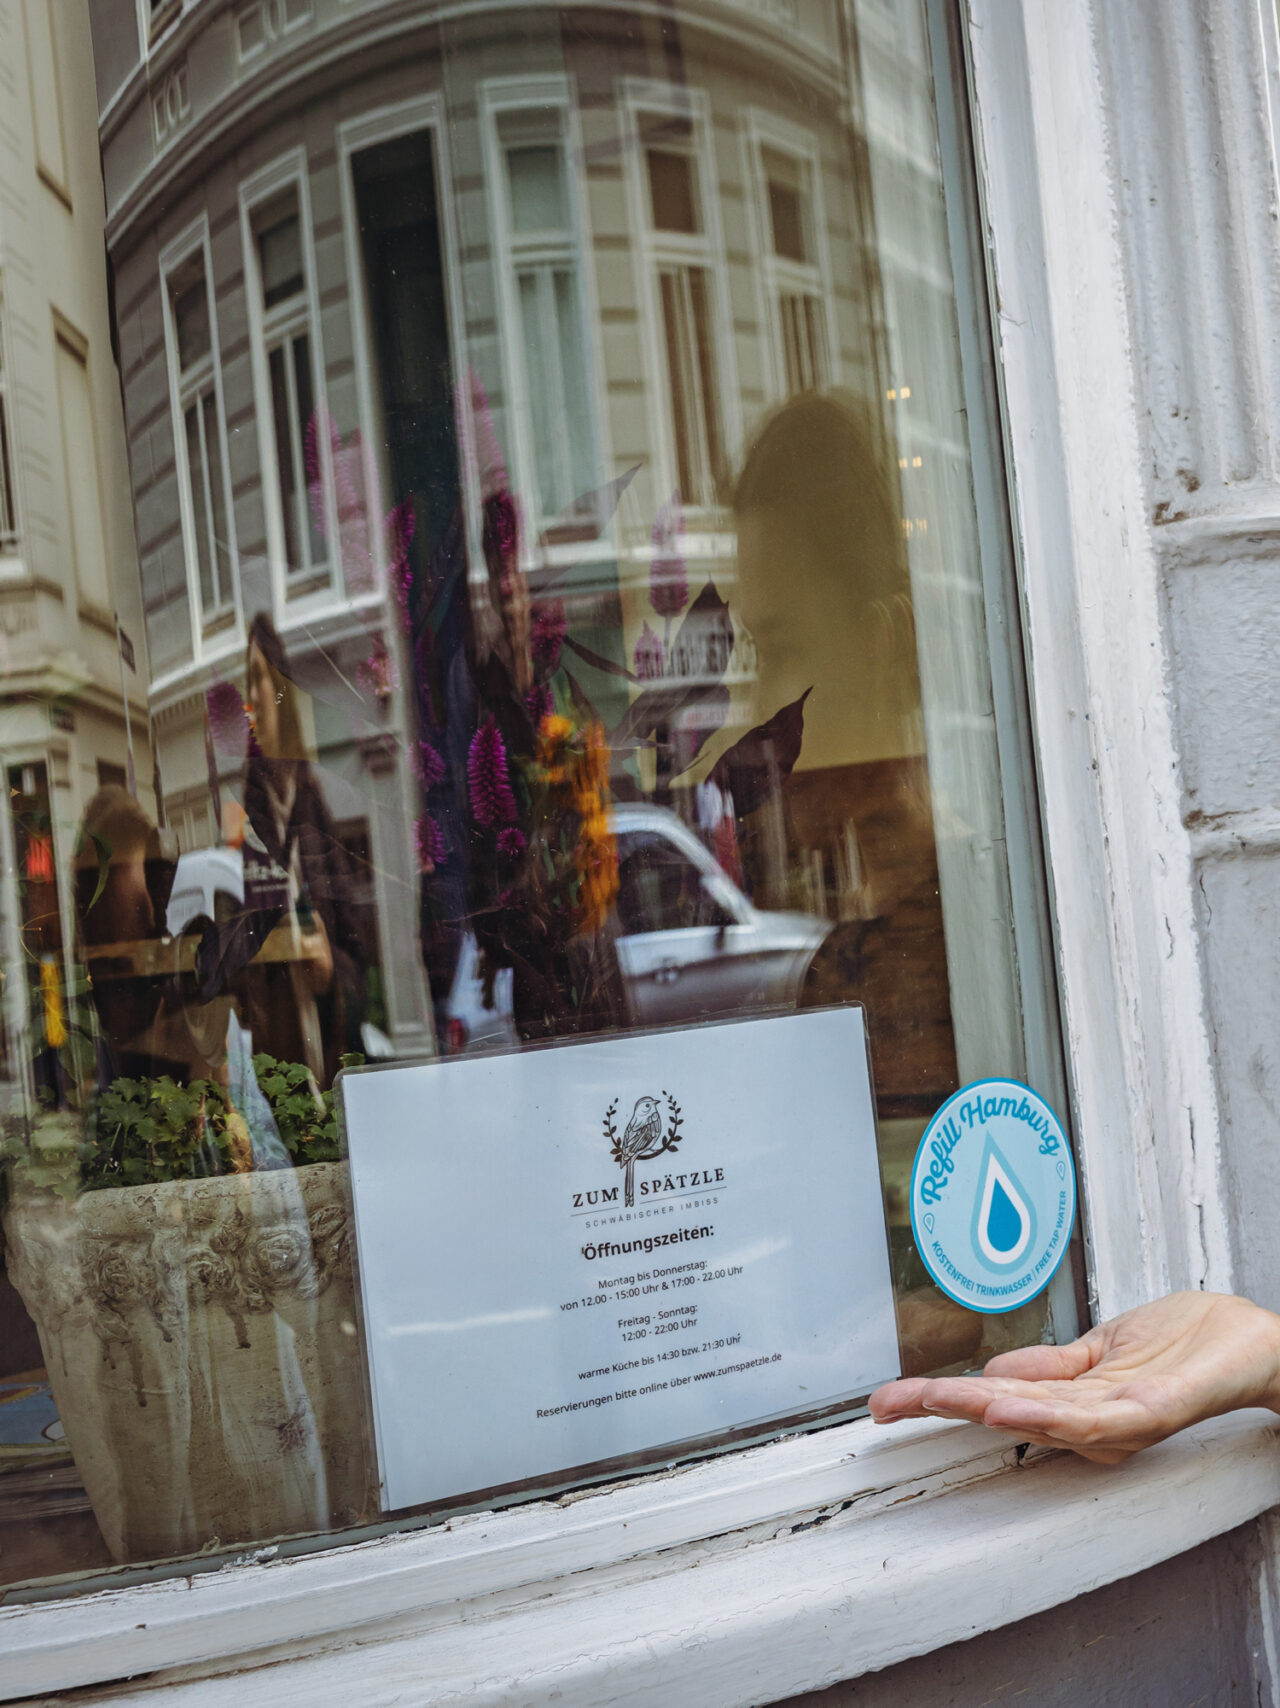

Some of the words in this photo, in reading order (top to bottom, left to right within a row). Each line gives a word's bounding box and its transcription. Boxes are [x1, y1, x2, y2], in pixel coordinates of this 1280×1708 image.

[920, 1118, 962, 1206] Refill
[959, 1095, 1061, 1157] Hamburg
[572, 1187, 619, 1207] ZUM
[640, 1168, 725, 1195] SPÄTZLE
[585, 1205, 674, 1228] SCHWÄBISCHER
[680, 1197, 719, 1211] IMBISS
[584, 1225, 715, 1260] Öffnungszeiten:
[931, 1240, 974, 1292] KOSTENFREI
[976, 1276, 1033, 1297] TRINKWASSER
[1035, 1253, 1052, 1276] FREE
[1049, 1229, 1060, 1252] TAP
[1055, 1190, 1067, 1232] WATER
[560, 1302, 579, 1311] von
[581, 1294, 607, 1307] 12.00
[615, 1288, 640, 1300] 15:00
[642, 1284, 659, 1295] Uhr
[661, 1281, 669, 1290] &
[671, 1276, 695, 1288] 17:00
[702, 1270, 726, 1282] 22.00
[727, 1265, 744, 1276] Uhr
[598, 1273, 635, 1289] Montag
[637, 1272, 651, 1281] bis
[653, 1260, 708, 1278] Donnerstag:
[618, 1314, 650, 1328] Freitag
[658, 1304, 698, 1320] Sonntag:
[622, 1329, 647, 1342] 12:00
[654, 1322, 679, 1335] 22:00
[681, 1318, 698, 1329] Uhr
[578, 1366, 610, 1380] warme
[612, 1358, 640, 1371] Küche
[641, 1355, 655, 1366] bis
[657, 1349, 680, 1362] 14:30
[681, 1345, 700, 1357] bzw.
[702, 1339, 725, 1352] 21:30
[726, 1334, 742, 1346] Uhr
[536, 1393, 613, 1418] Reservierungen
[615, 1388, 637, 1401] bitte
[639, 1382, 668, 1395] online
[670, 1375, 692, 1387] über
[693, 1352, 783, 1382] www.zumspaetzle.de
